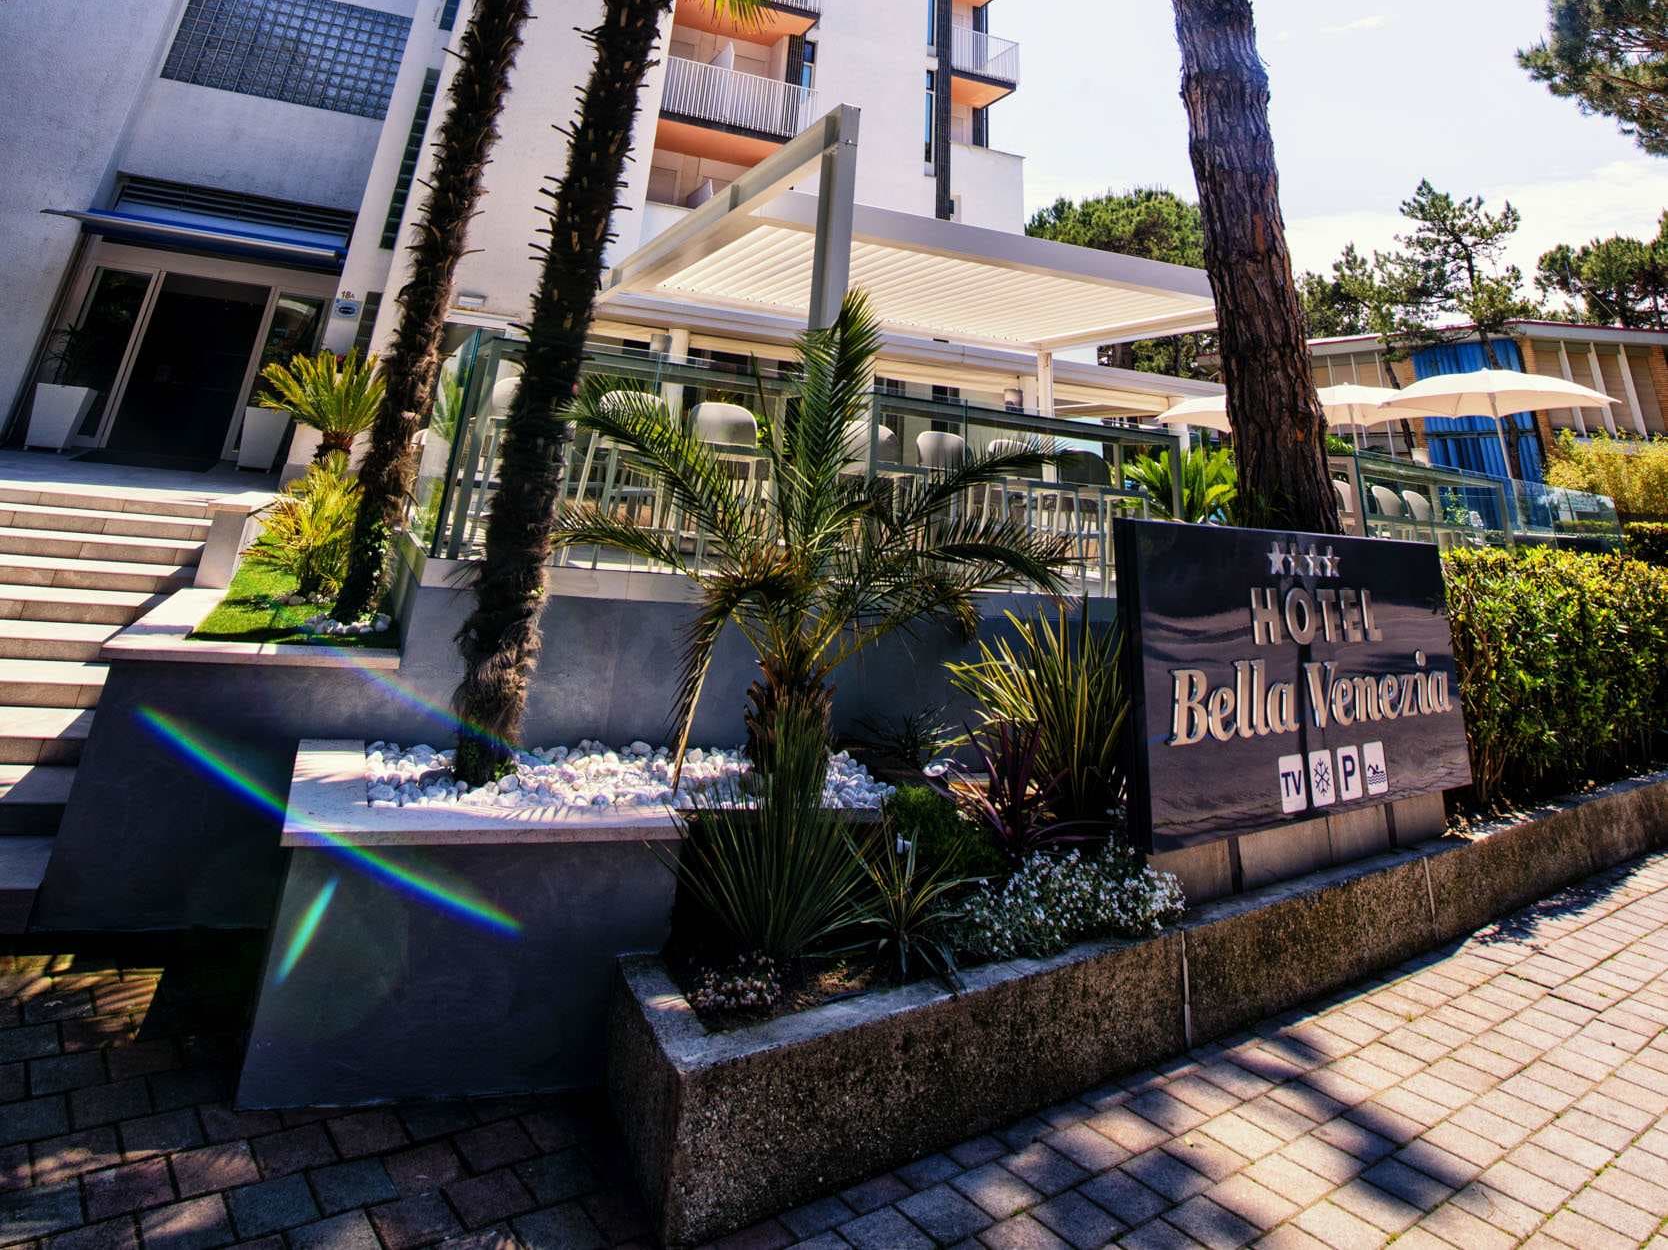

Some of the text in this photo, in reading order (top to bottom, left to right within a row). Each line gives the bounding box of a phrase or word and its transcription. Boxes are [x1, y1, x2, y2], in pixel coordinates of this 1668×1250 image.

[1251, 587, 1383, 645] HOTEL
[1166, 649, 1453, 747] Bella Venezia
[1281, 770, 1302, 797] TV
[1342, 755, 1355, 792] P
